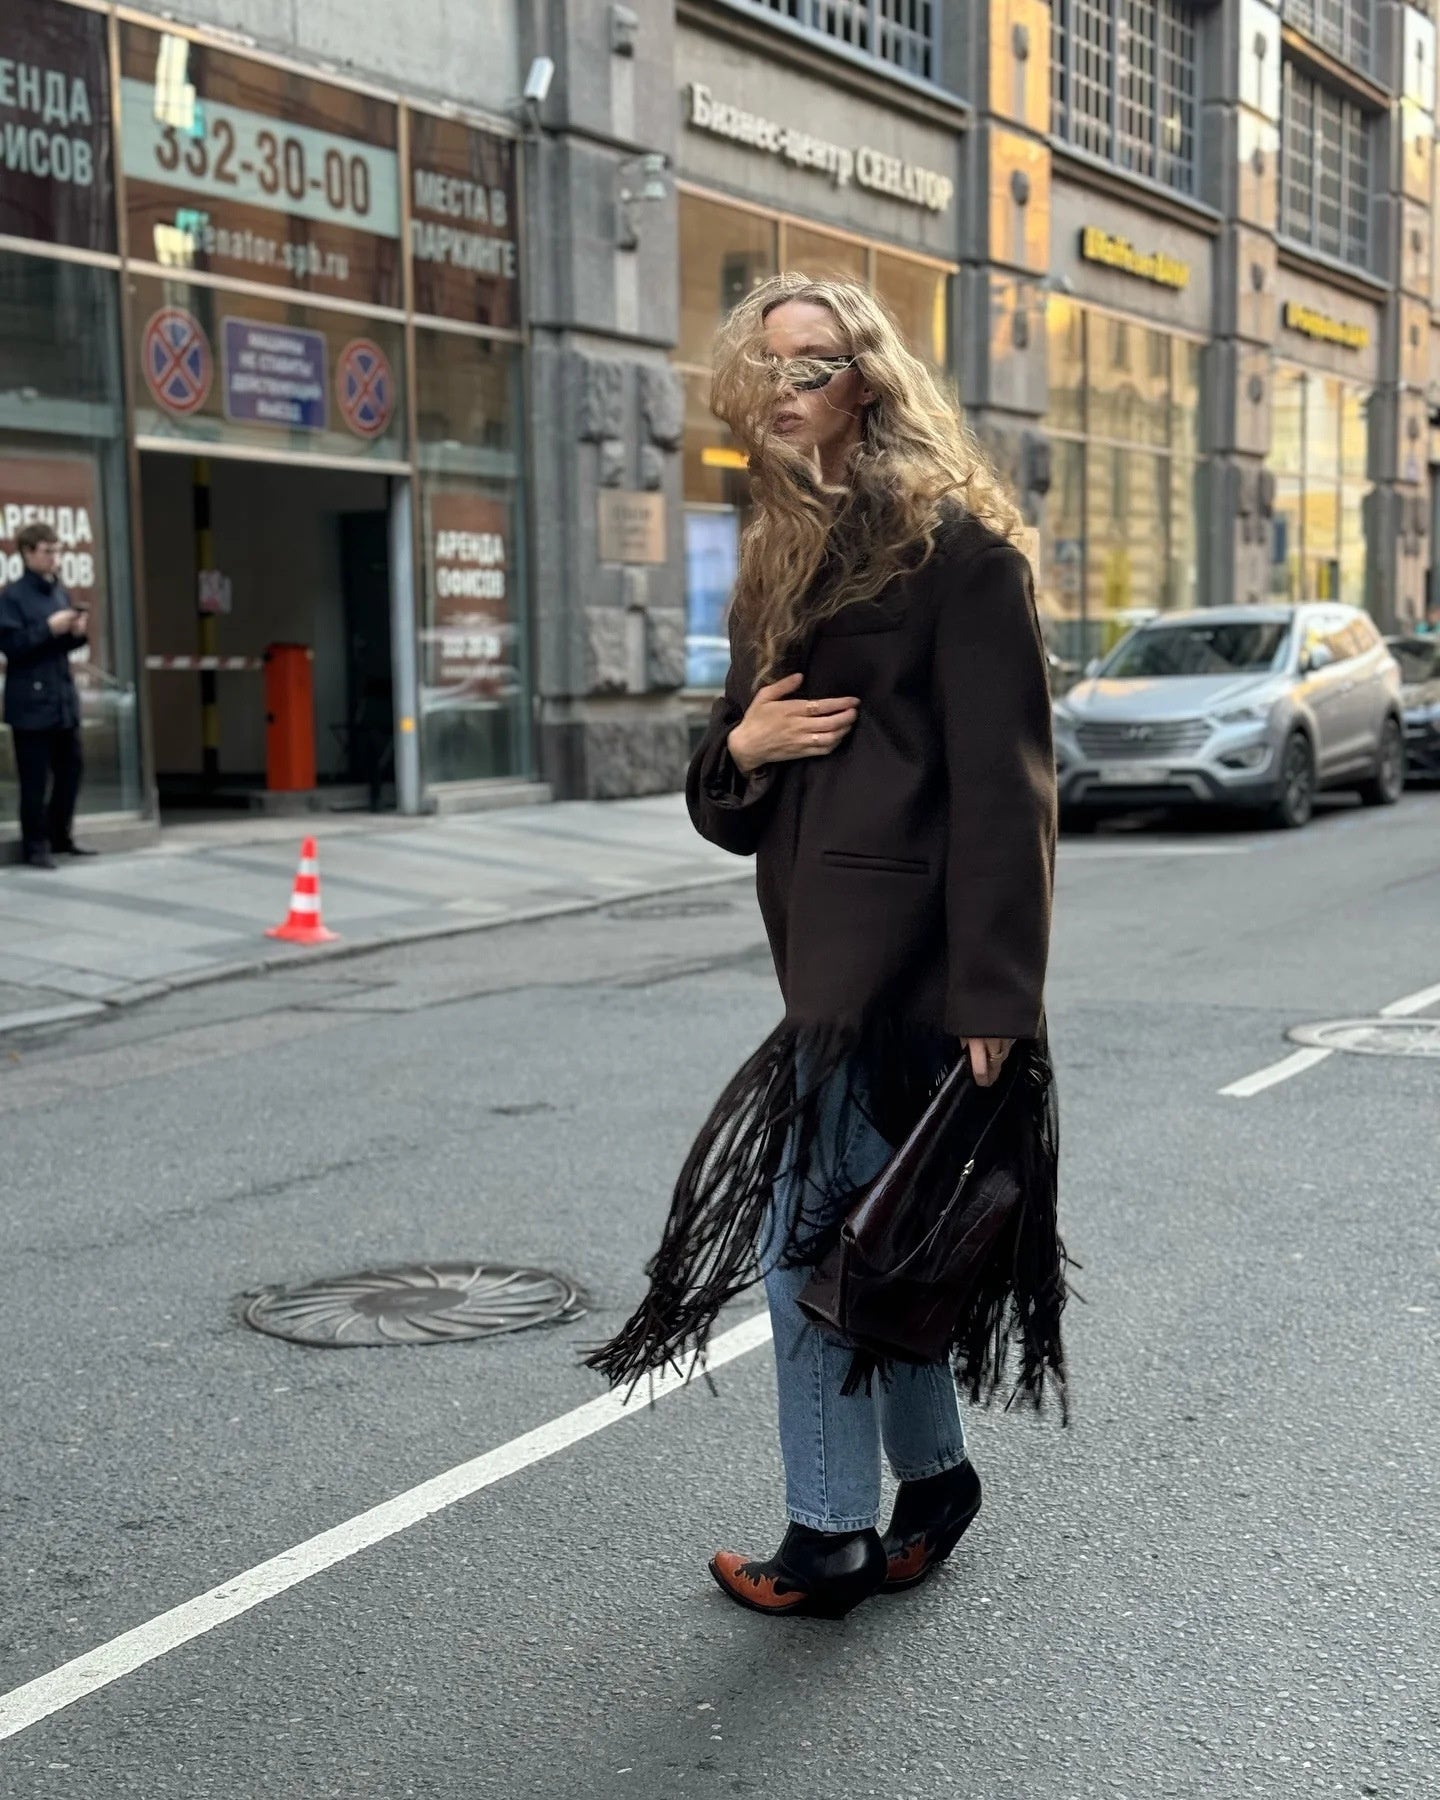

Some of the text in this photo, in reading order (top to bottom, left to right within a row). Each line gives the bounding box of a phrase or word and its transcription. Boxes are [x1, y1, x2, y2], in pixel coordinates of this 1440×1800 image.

[0, 121, 94, 187] ИСОВ
[155, 111, 369, 217] 332-30-00
[691, 82, 954, 212] Бизнес-центр СЕНАТОР
[414, 168, 507, 228] МЕСТА В
[193, 222, 348, 281] enator.spb.ru
[409, 218, 516, 279] ПАРКИНГЕ
[0, 503, 93, 547] РЕНДА
[436, 529, 505, 567] АРЕНДА
[436, 567, 505, 600] ОФИСОВ
